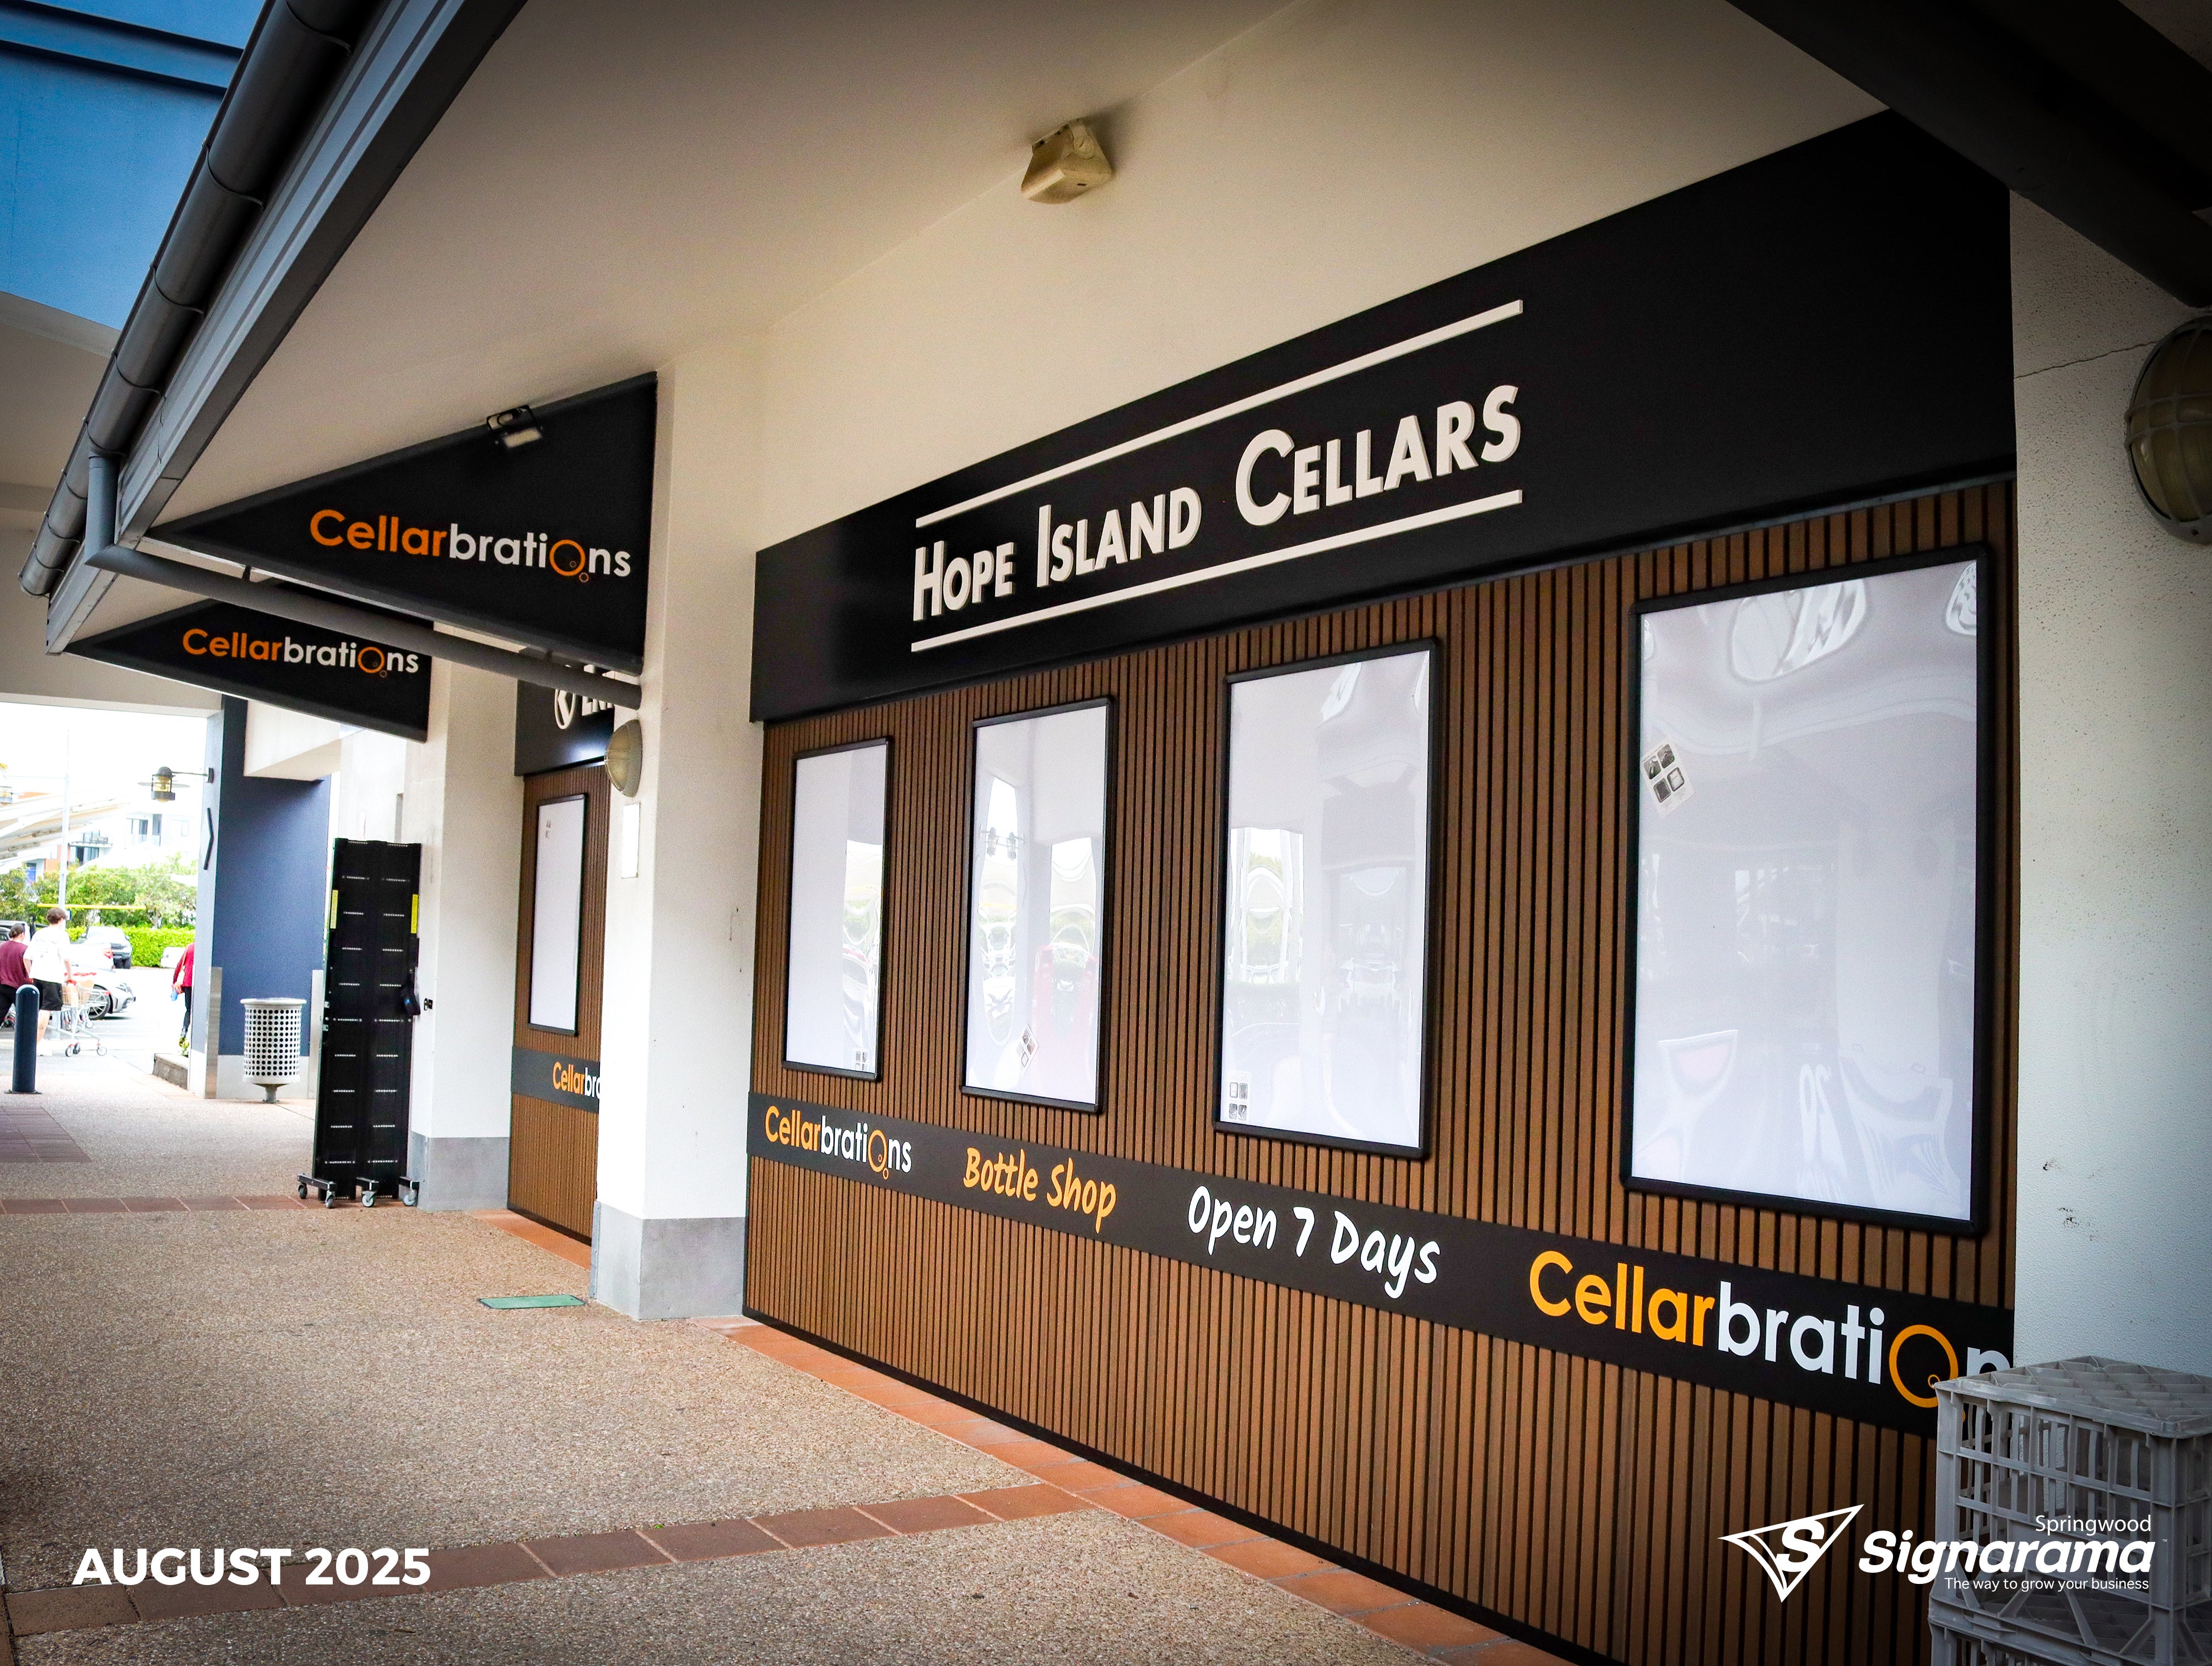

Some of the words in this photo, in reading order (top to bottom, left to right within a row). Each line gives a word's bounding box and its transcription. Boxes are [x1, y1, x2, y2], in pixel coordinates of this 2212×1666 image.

[913, 540, 1015, 621] HOPE
[1037, 486, 1202, 588] ISLAND
[1236, 385, 1522, 527] CELLARS
[962, 1147, 1039, 1202] Bottle
[1046, 1157, 1117, 1234] Shop
[1187, 1185, 1277, 1256] Open
[1293, 1207, 1315, 1257] 7
[1330, 1210, 1442, 1299] Days
